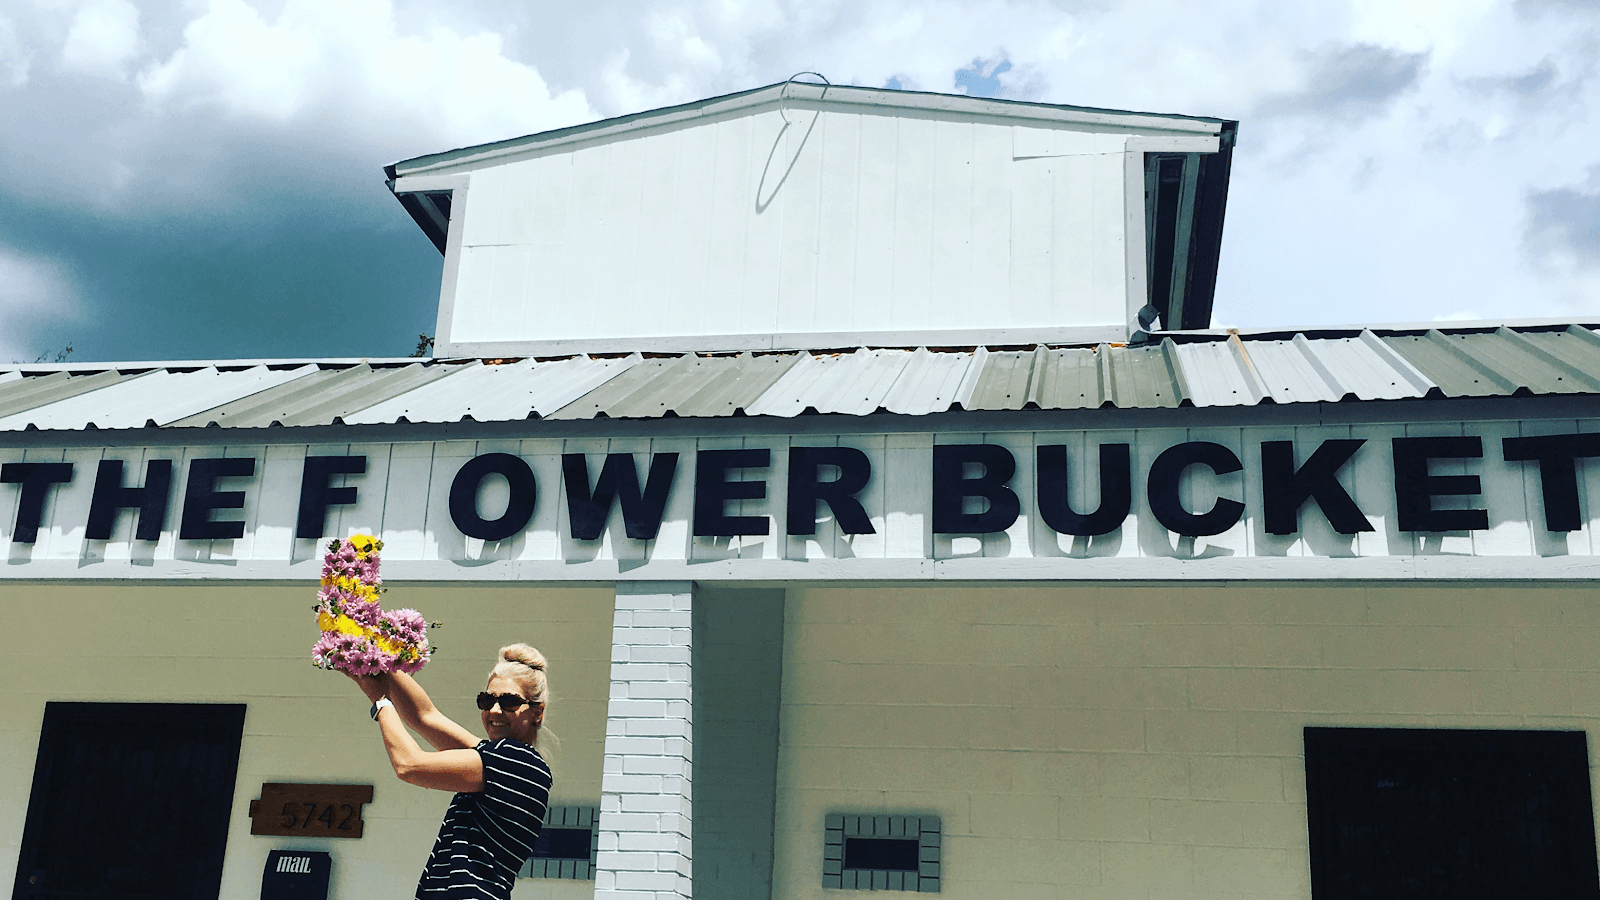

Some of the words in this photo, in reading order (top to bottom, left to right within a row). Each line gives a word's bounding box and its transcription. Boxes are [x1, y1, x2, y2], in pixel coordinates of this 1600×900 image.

[0, 458, 256, 542] THE
[933, 433, 1600, 537] BUCKET
[280, 802, 354, 830] 5742
